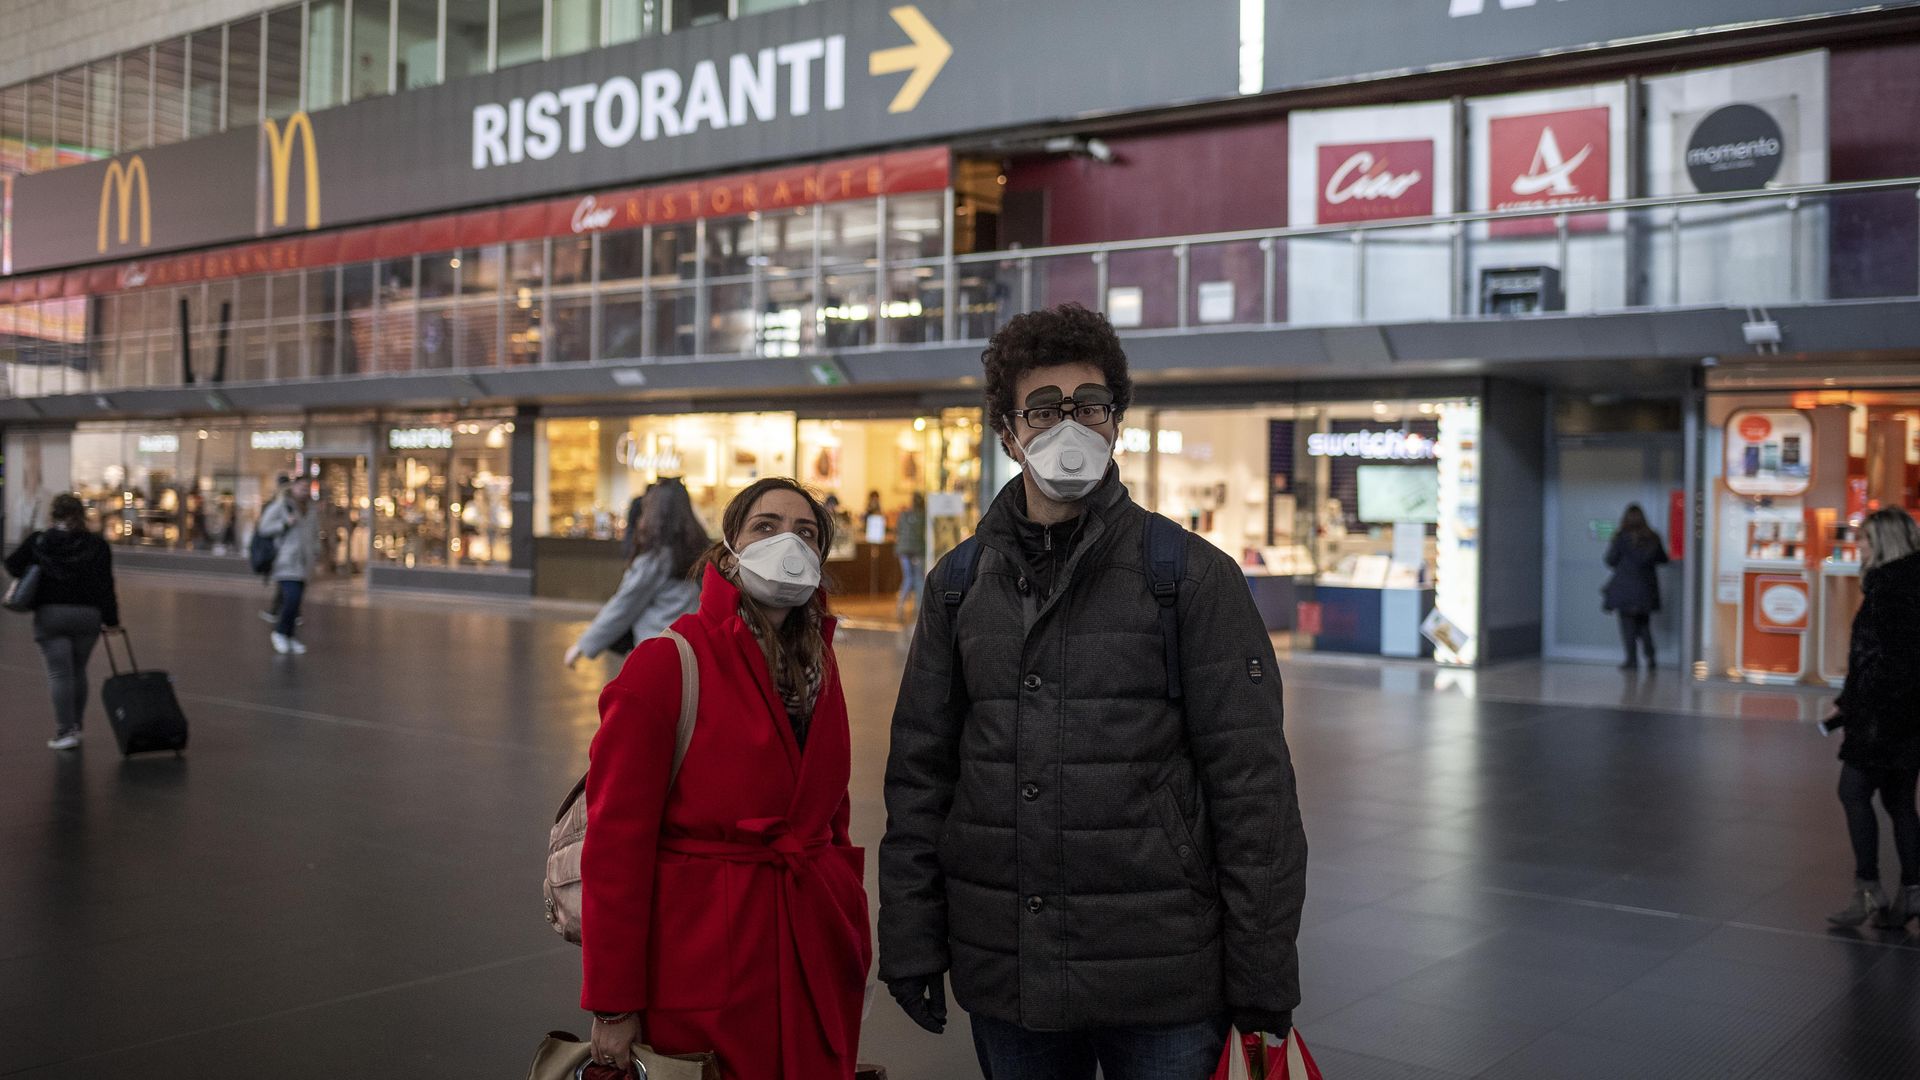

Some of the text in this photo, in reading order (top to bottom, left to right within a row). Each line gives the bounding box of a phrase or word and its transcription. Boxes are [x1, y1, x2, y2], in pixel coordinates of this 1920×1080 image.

[472, 35, 846, 170] RISTORANTI
[1325, 151, 1422, 204] Ciao
[1688, 137, 1780, 166] momento
[626, 166, 884, 223] RISTORANTE
